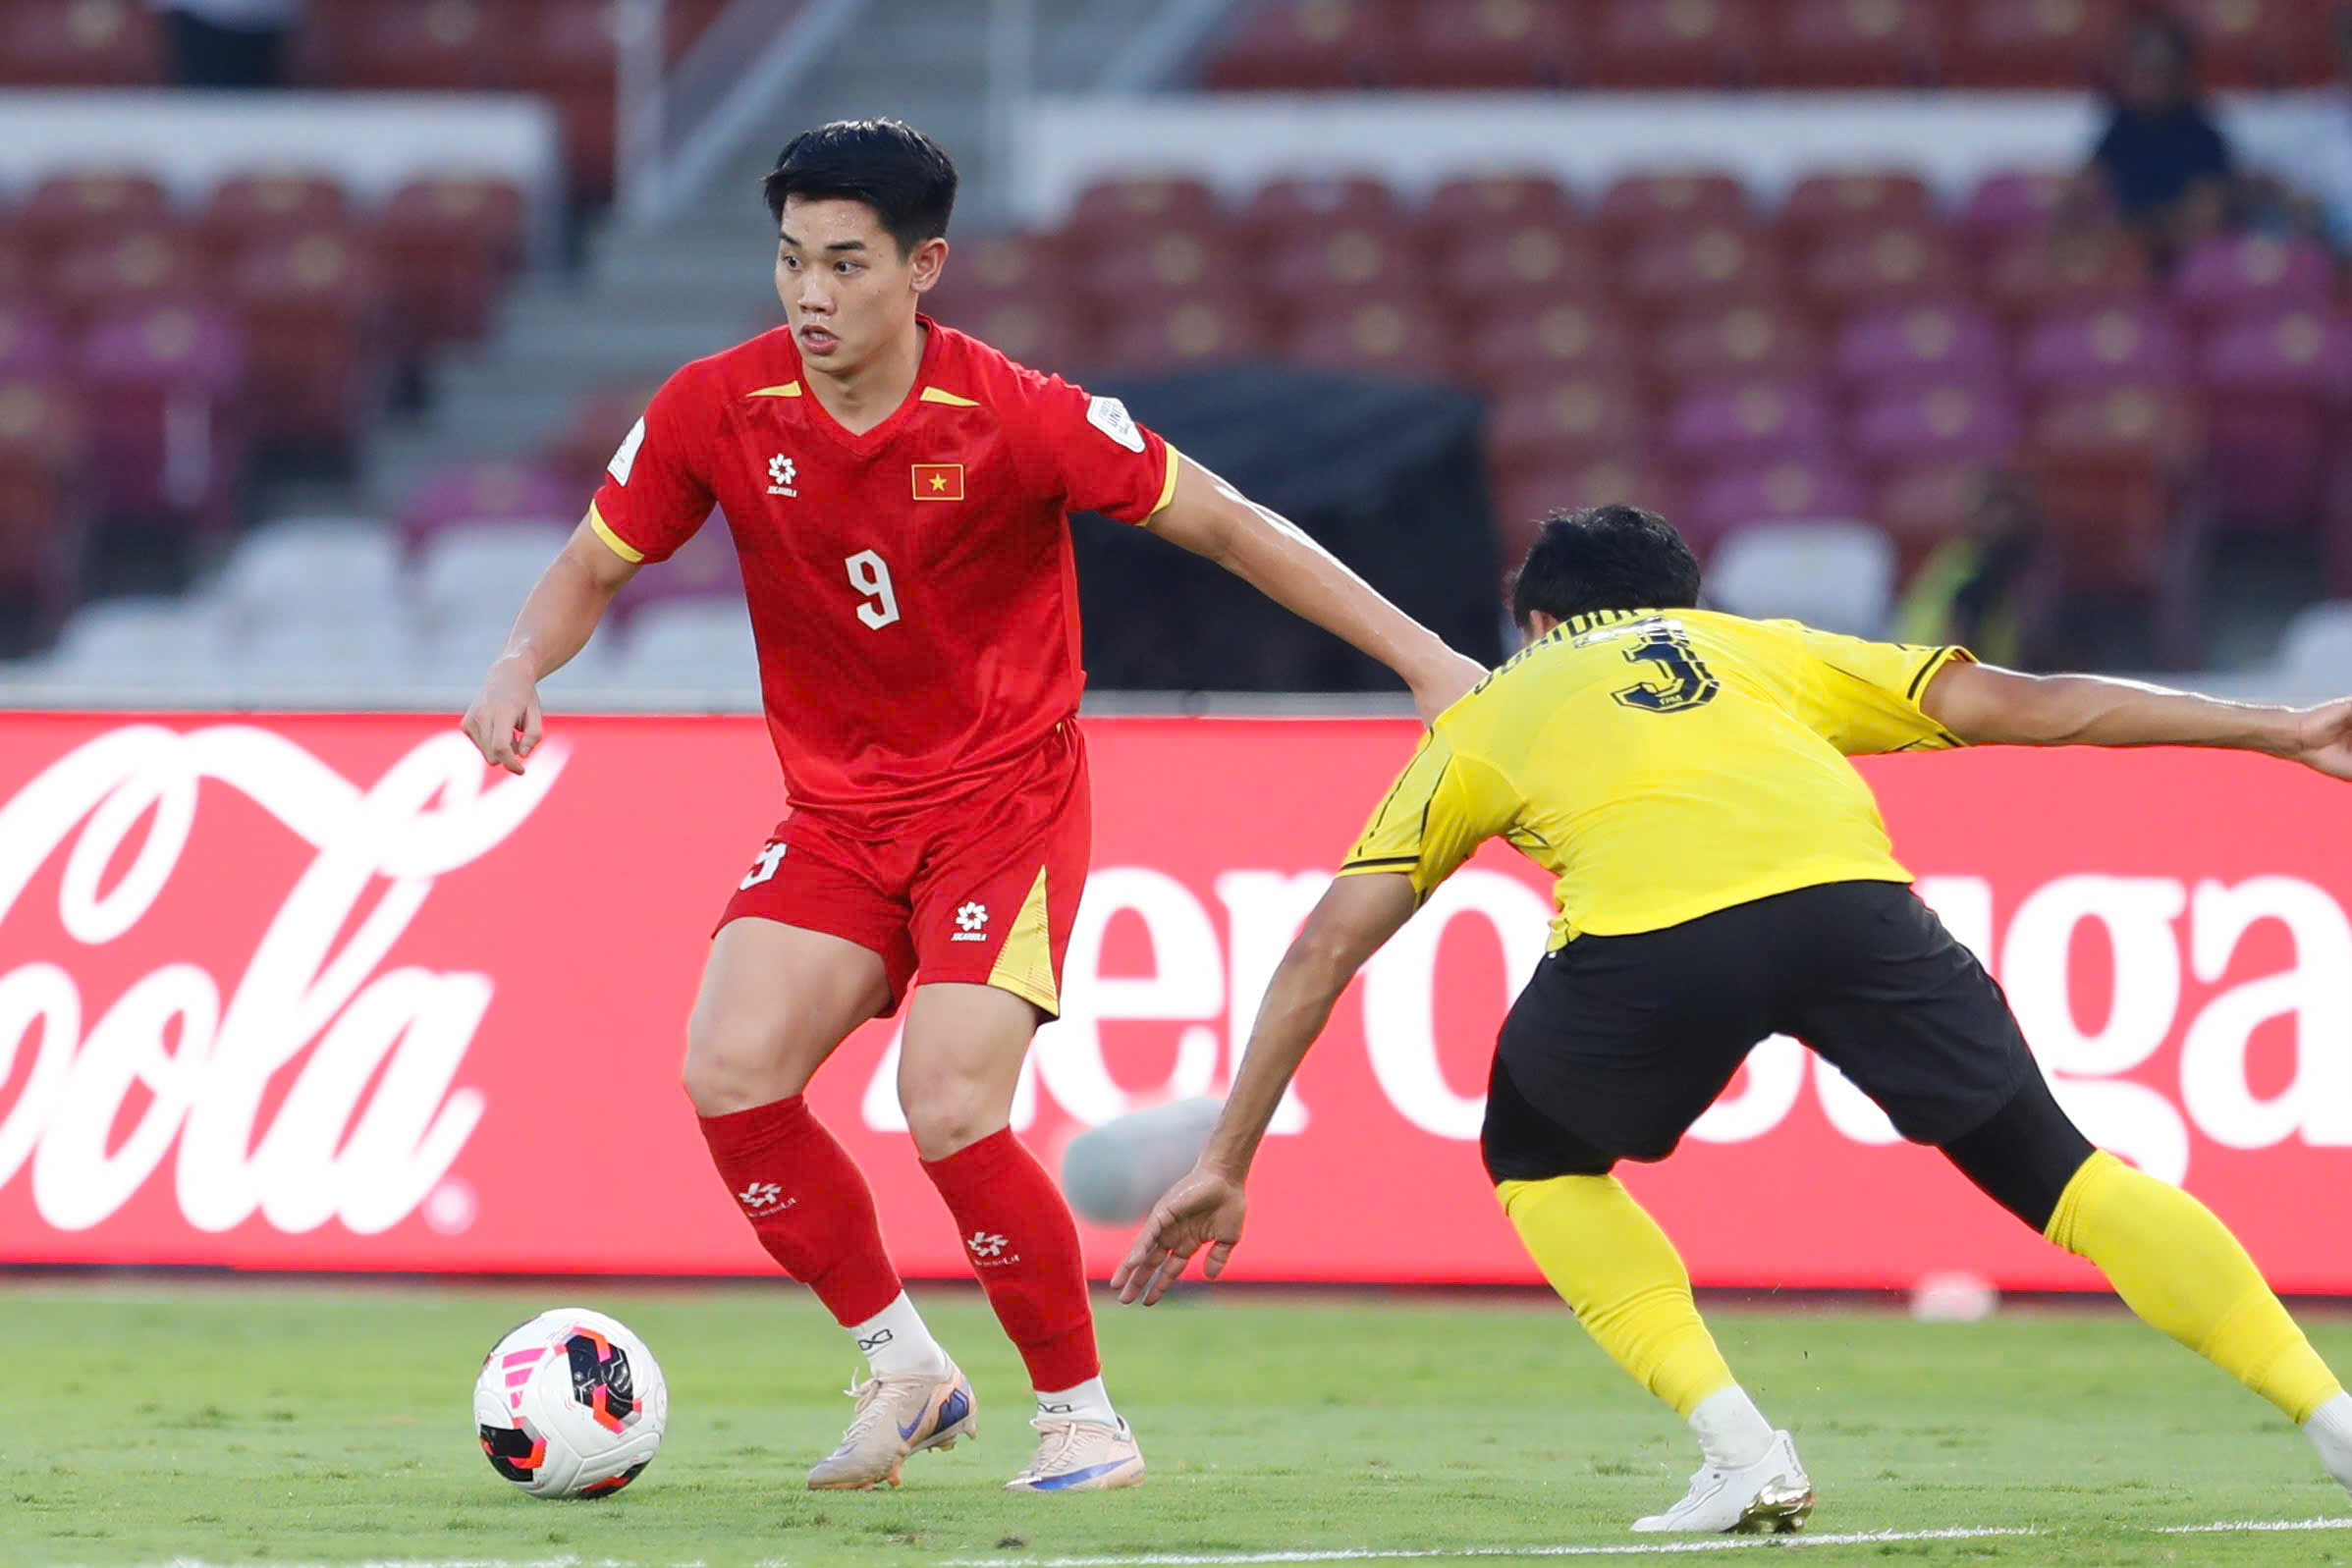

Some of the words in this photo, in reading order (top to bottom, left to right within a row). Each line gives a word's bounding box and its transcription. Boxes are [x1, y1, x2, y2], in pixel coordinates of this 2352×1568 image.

[845, 549, 900, 630] 9
[1611, 616, 1720, 714] 3
[861, 866, 1561, 1139] ero
